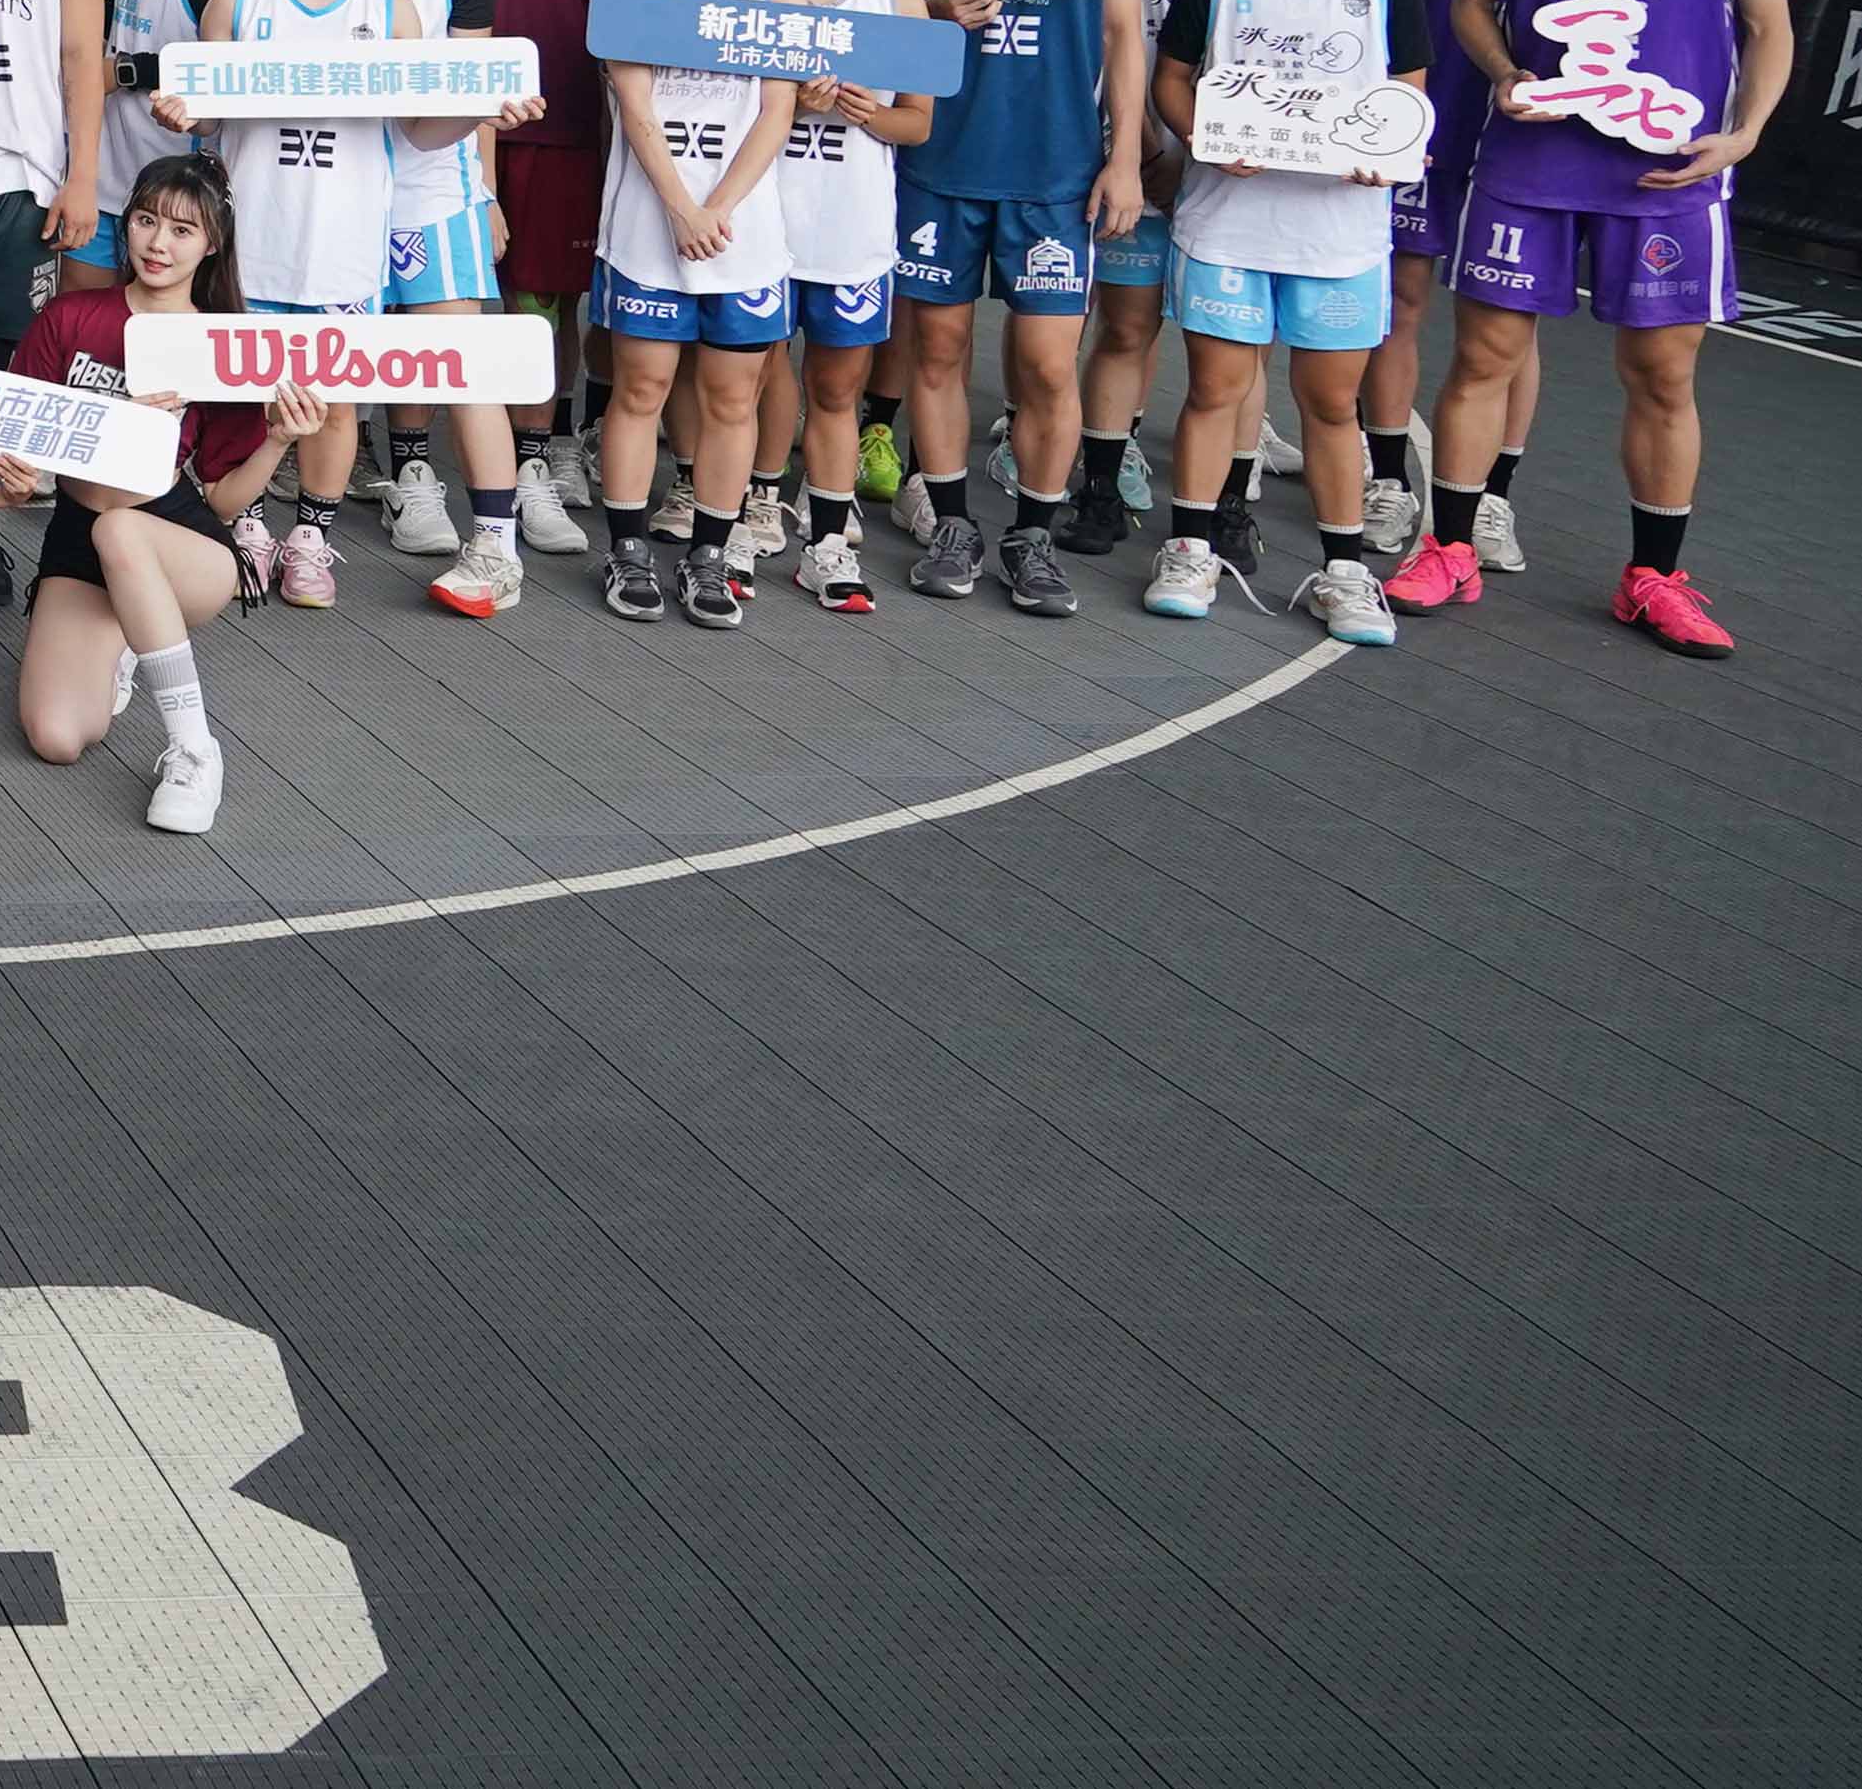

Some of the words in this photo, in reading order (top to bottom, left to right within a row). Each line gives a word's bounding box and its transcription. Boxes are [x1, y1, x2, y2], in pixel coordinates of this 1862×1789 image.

[717, 42, 831, 74] 北市大附小
[174, 59, 524, 97] 王山頌建築師事務所
[909, 220, 938, 257] 4
[1487, 222, 1524, 265] 11
[1463, 261, 1536, 292] FOOTER
[1188, 295, 1265, 323] FOOTER
[206, 326, 468, 389] Wilson
